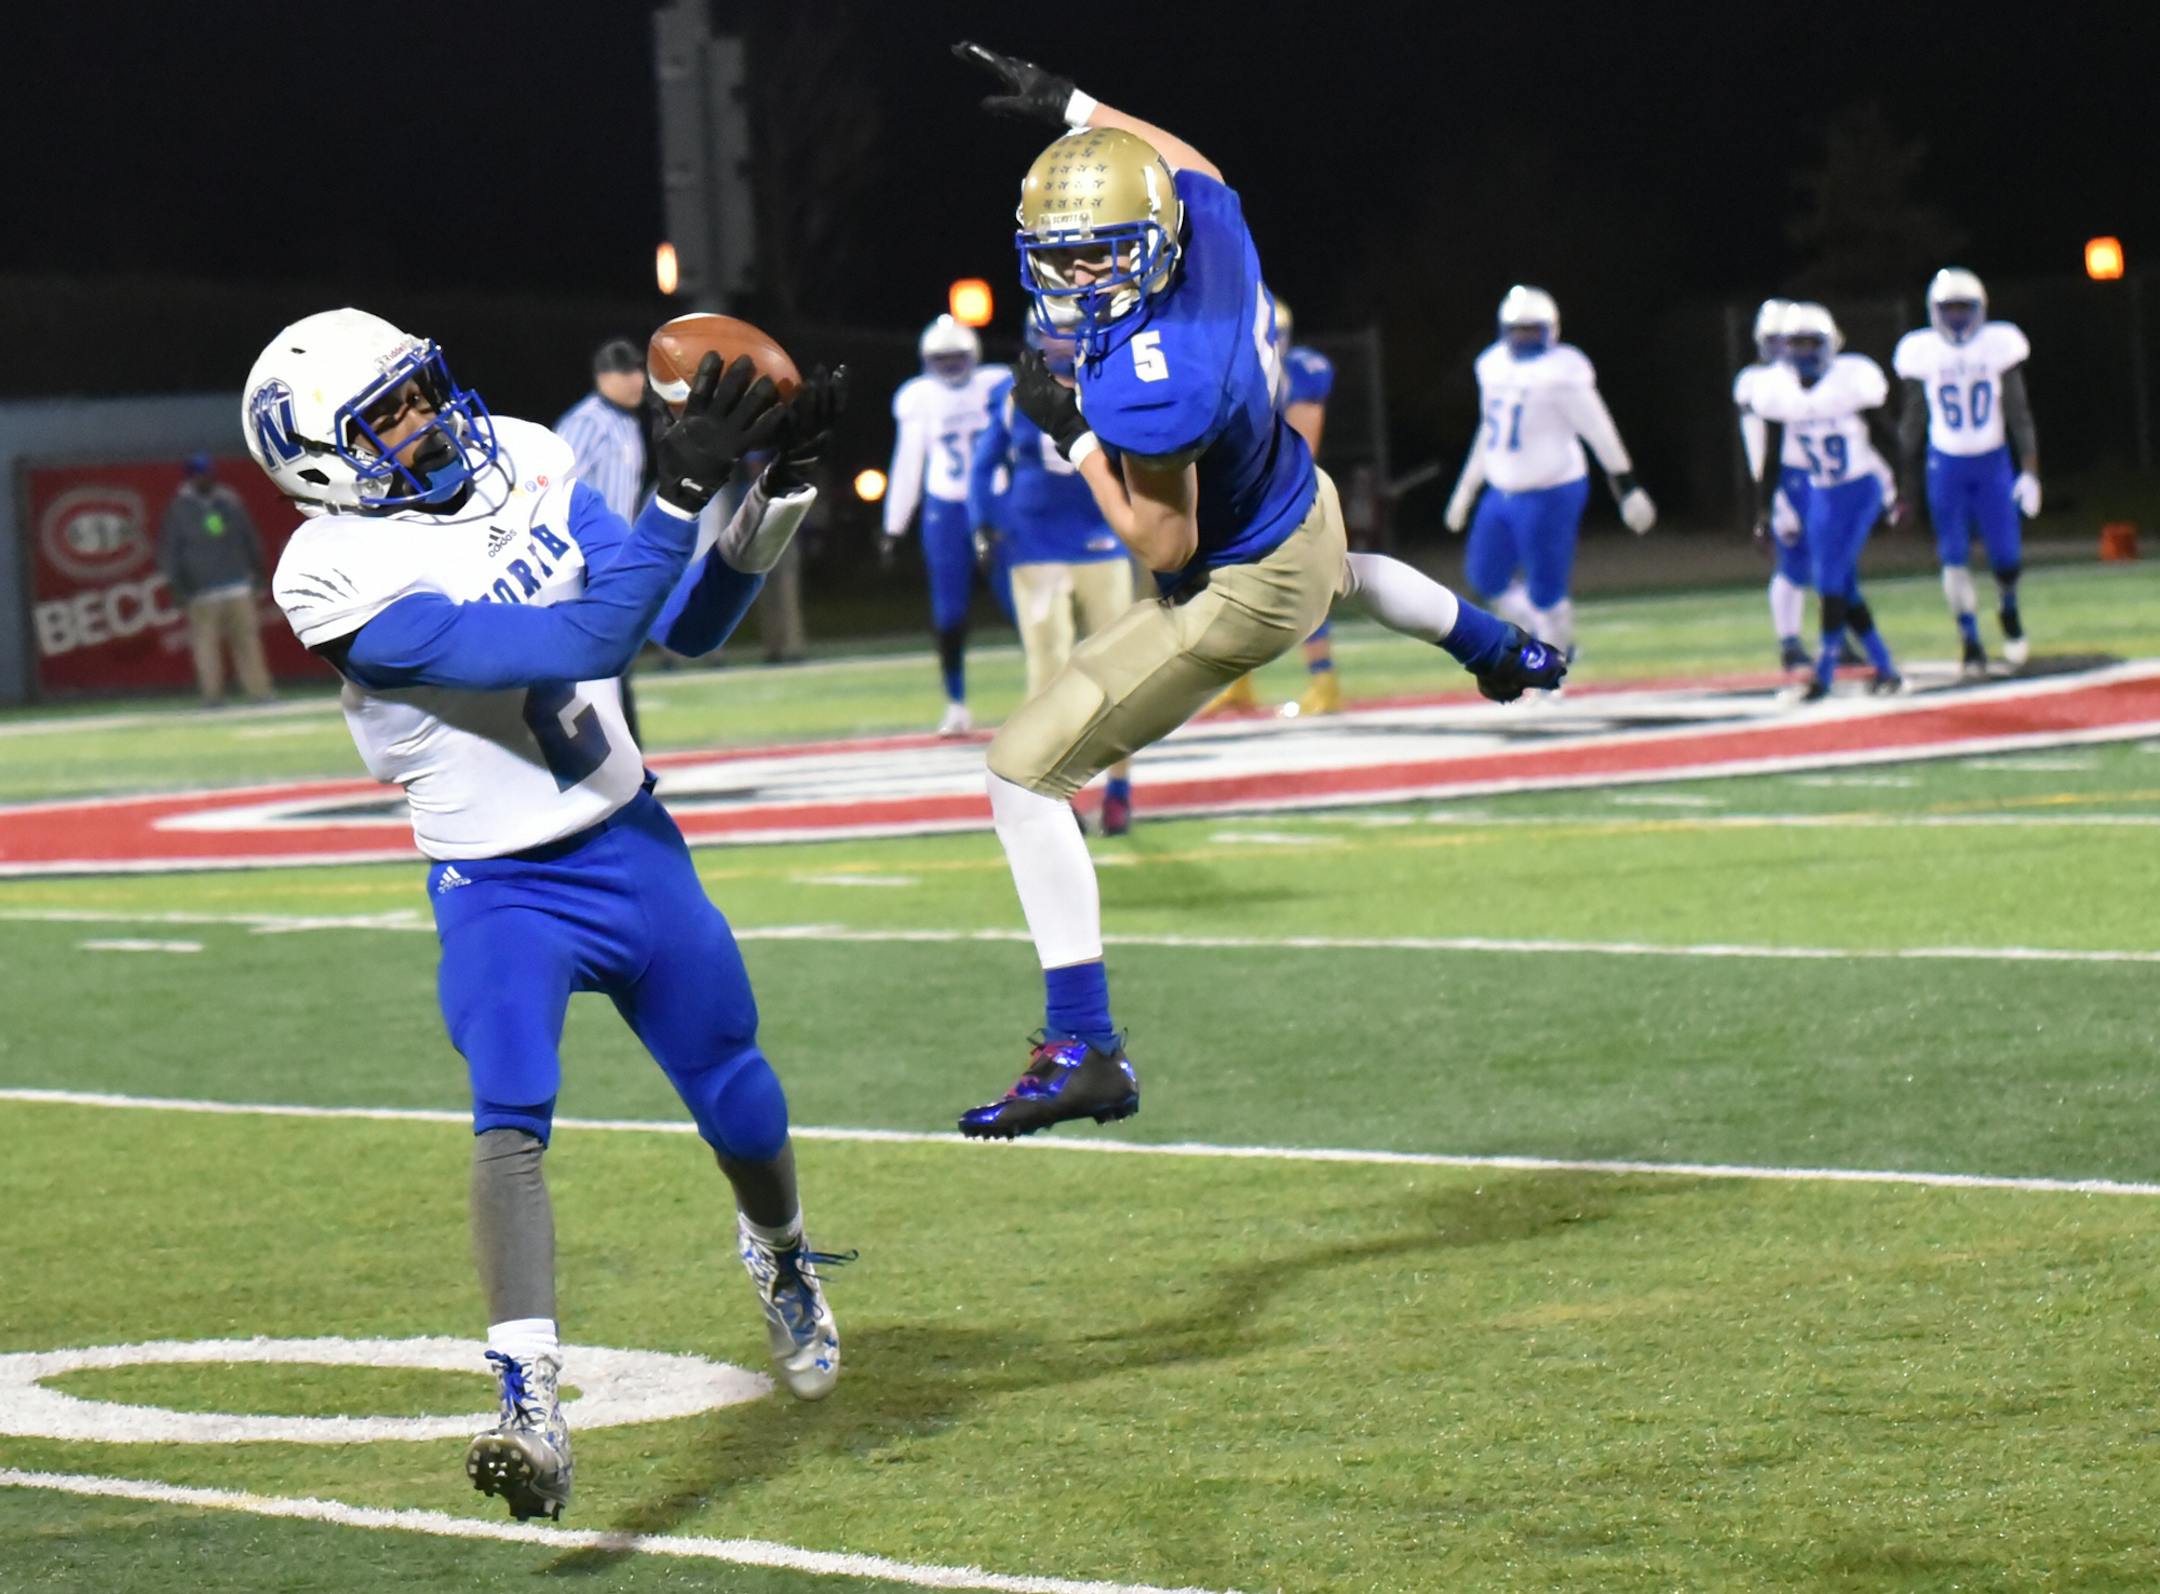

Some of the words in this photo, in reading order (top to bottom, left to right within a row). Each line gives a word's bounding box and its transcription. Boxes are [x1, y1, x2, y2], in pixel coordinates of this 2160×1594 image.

[1130, 330, 1169, 382] 5
[250, 388, 308, 473] N
[1486, 398, 1524, 451] 51
[1938, 380, 1992, 431] 60
[479, 523, 571, 603] ORTH
